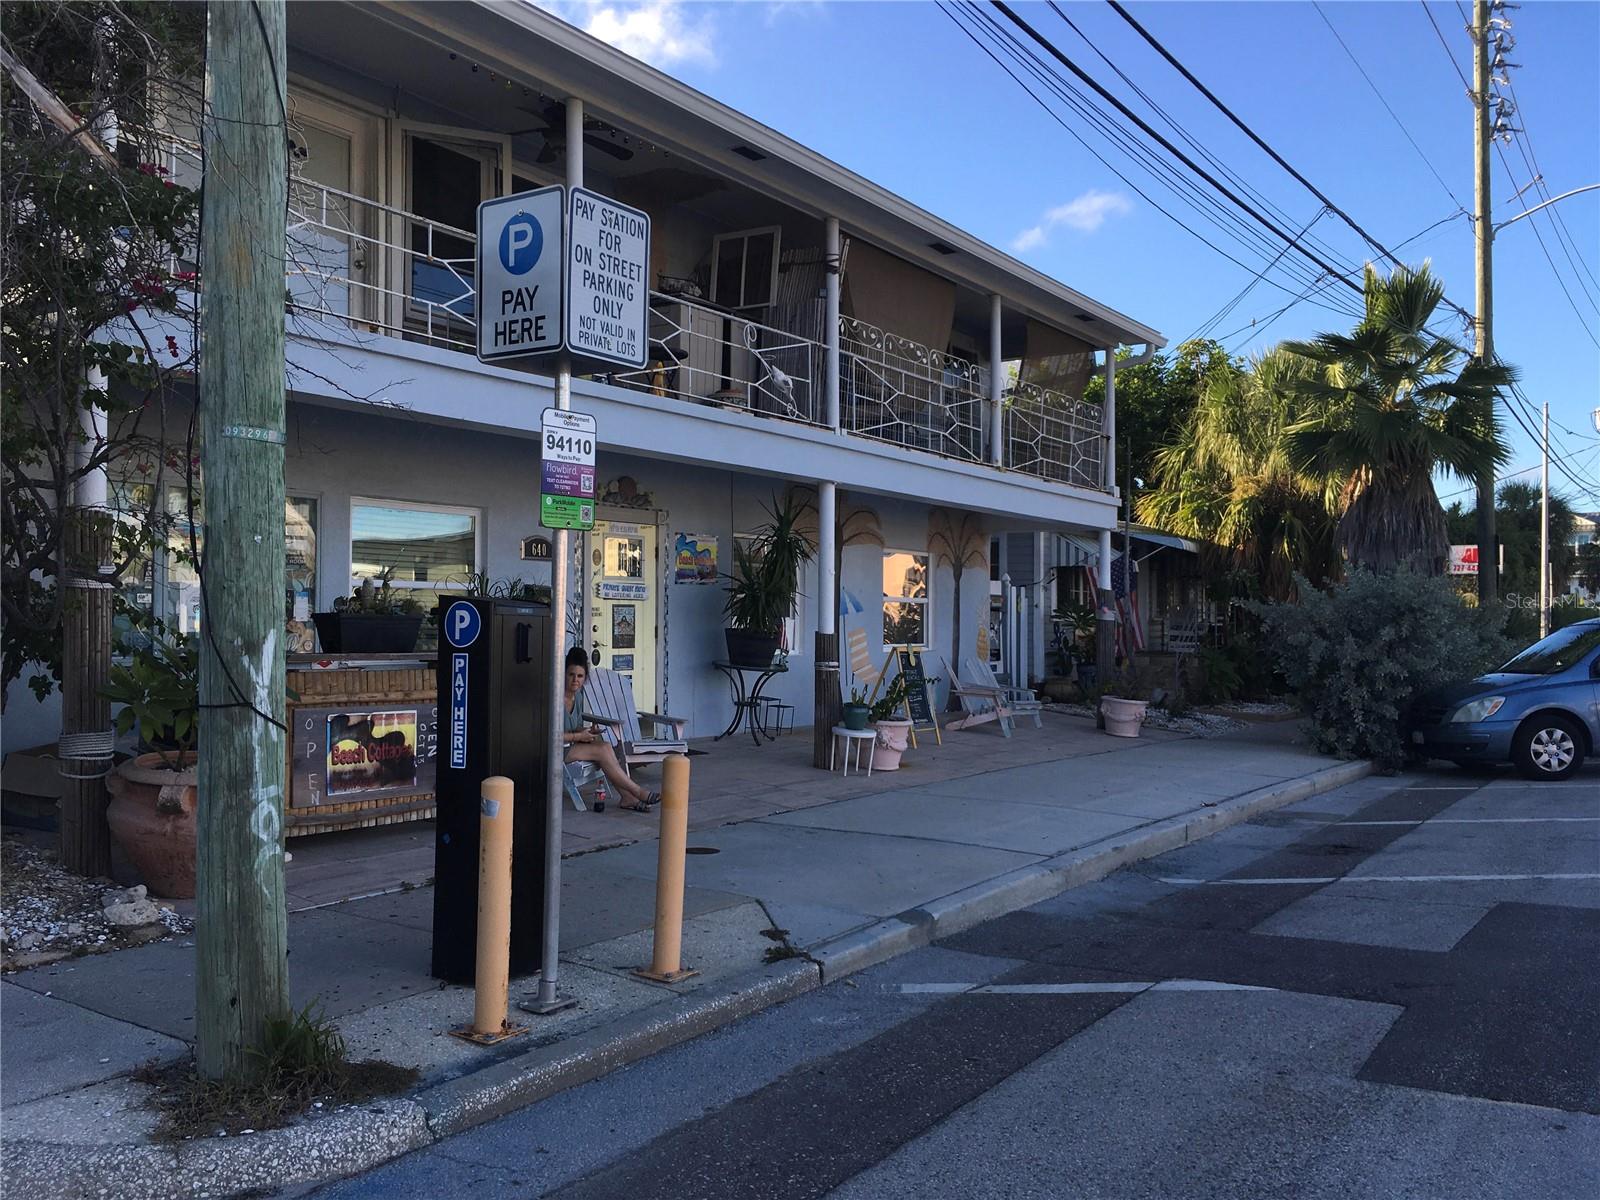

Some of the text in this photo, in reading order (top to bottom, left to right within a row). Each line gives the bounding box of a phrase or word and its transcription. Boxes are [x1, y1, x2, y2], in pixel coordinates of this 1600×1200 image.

[575, 198, 644, 240] PAY STATION
[508, 222, 533, 267] P
[599, 229, 621, 254] FOR
[575, 244, 642, 282] ON STREET
[502, 285, 539, 315] PAY
[583, 270, 634, 301] PARKING
[593, 296, 623, 320] ONLY
[494, 315, 546, 347] HERE
[579, 315, 636, 342] NOT VALID IN
[579, 331, 636, 357] PRIVATE LOTS
[546, 434, 592, 455] 94110
[531, 543, 547, 556] 640
[455, 609, 471, 640] P
[453, 658, 465, 763] PAY HERE
[305, 718, 320, 805] OPEN
[331, 744, 366, 766] Beach
